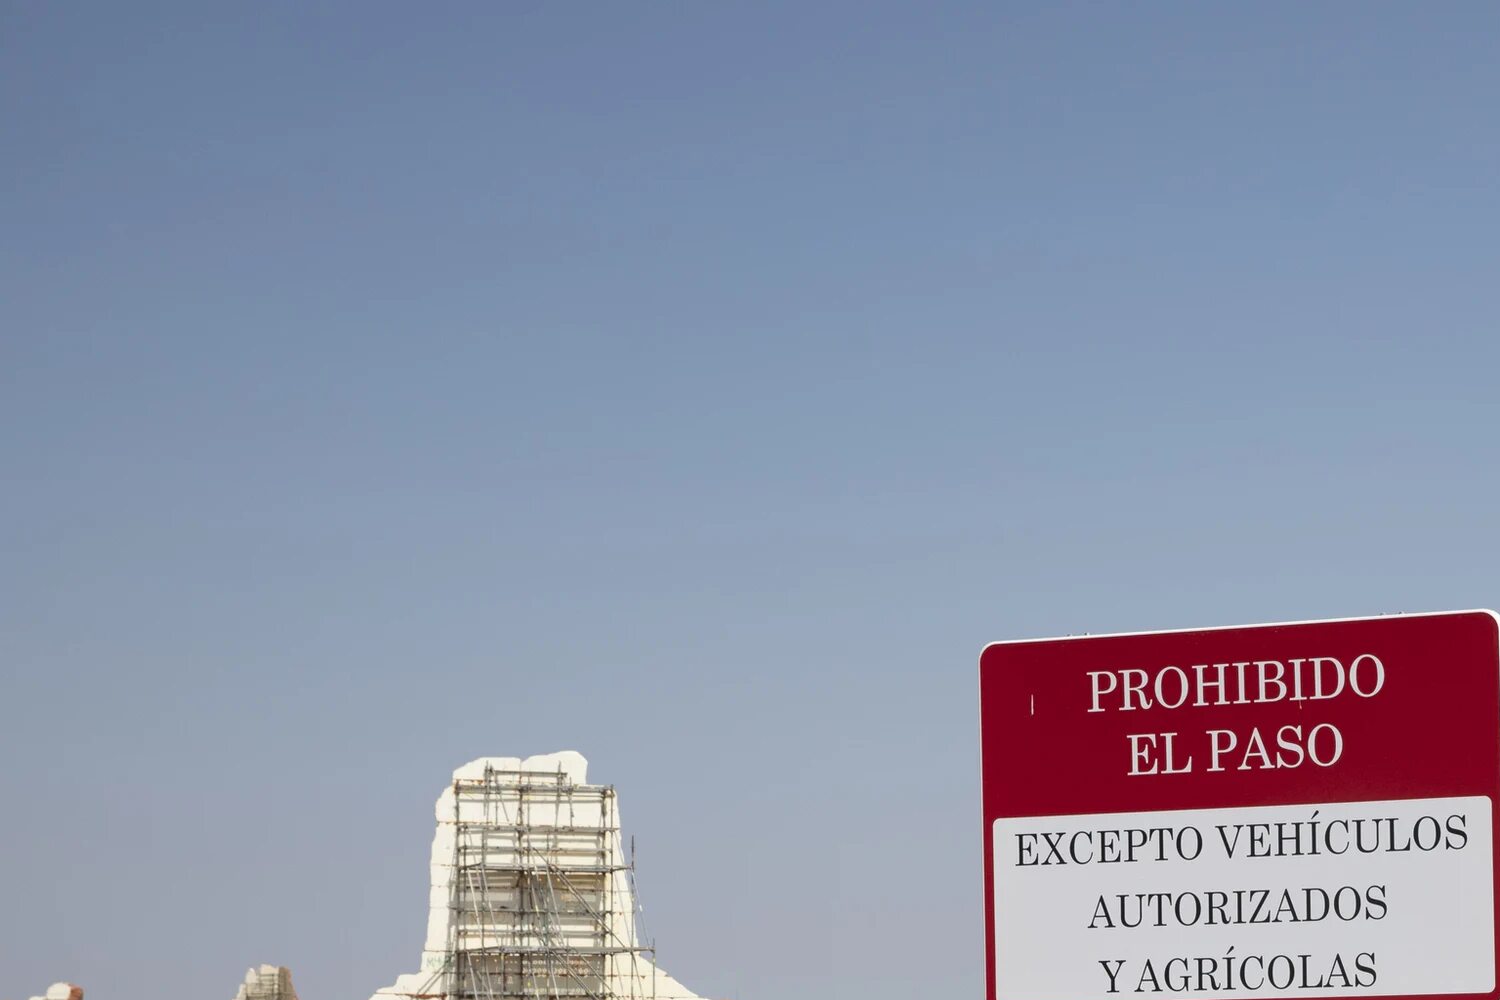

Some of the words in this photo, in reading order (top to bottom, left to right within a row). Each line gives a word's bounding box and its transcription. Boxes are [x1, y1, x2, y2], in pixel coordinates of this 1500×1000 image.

[1086, 654, 1386, 713] PROHIBIDO
[1126, 732, 1193, 776] EL
[1205, 723, 1344, 773] PASO
[1014, 825, 1203, 867] EXCEPTO
[1214, 811, 1468, 859] VEHÍCULOS
[1087, 884, 1388, 929] AUTORIZADOS
[1098, 960, 1127, 994] Y
[1133, 945, 1377, 993] AGRÍCOLAS
